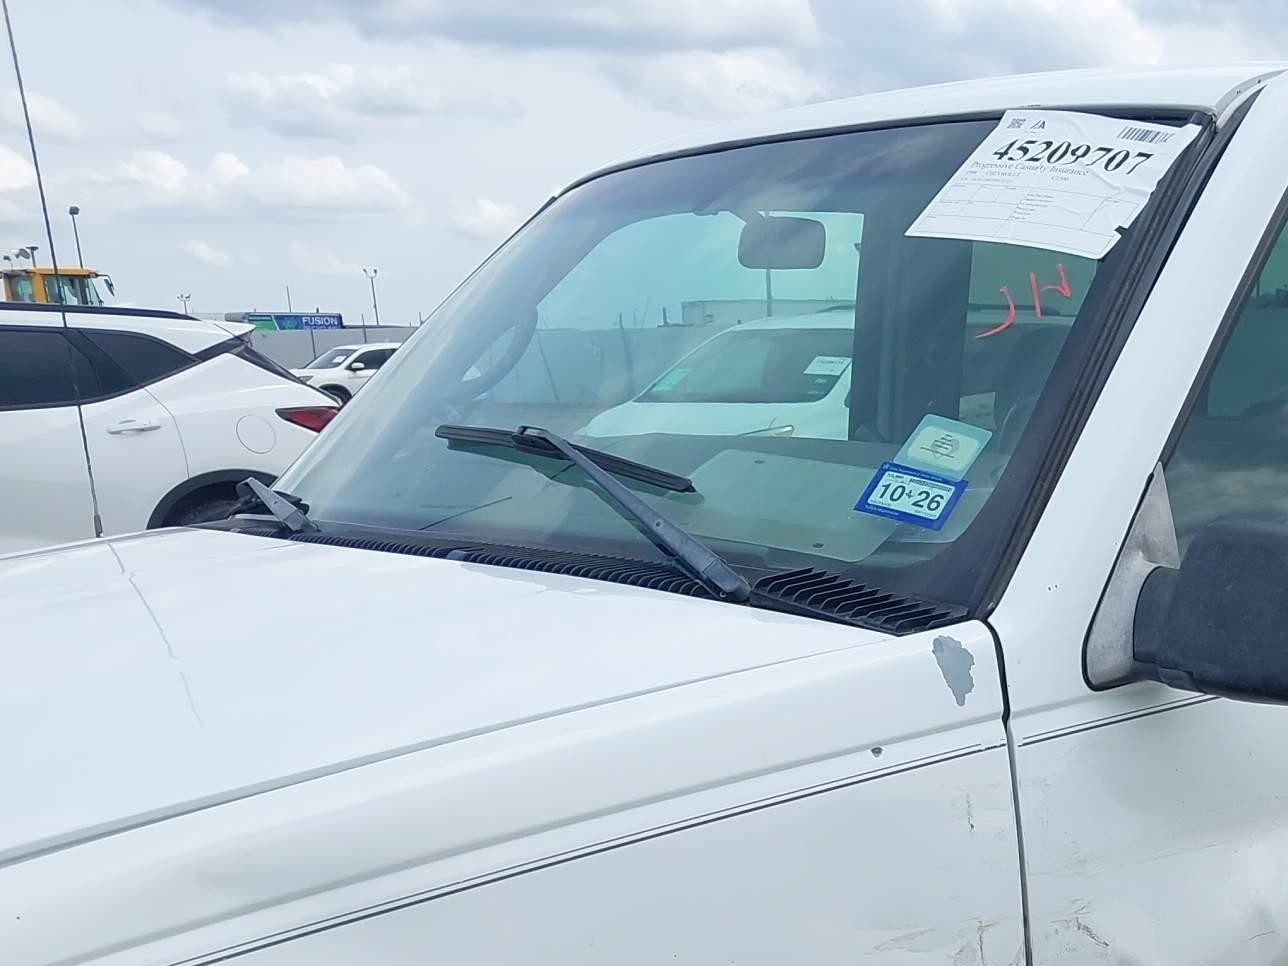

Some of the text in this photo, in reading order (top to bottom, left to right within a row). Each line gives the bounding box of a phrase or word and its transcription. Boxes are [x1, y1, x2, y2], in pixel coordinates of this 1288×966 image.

[992, 139, 1154, 175] 45209707
[302, 316, 338, 326] FUSION
[877, 482, 906, 502] 10
[911, 490, 945, 512] 26
